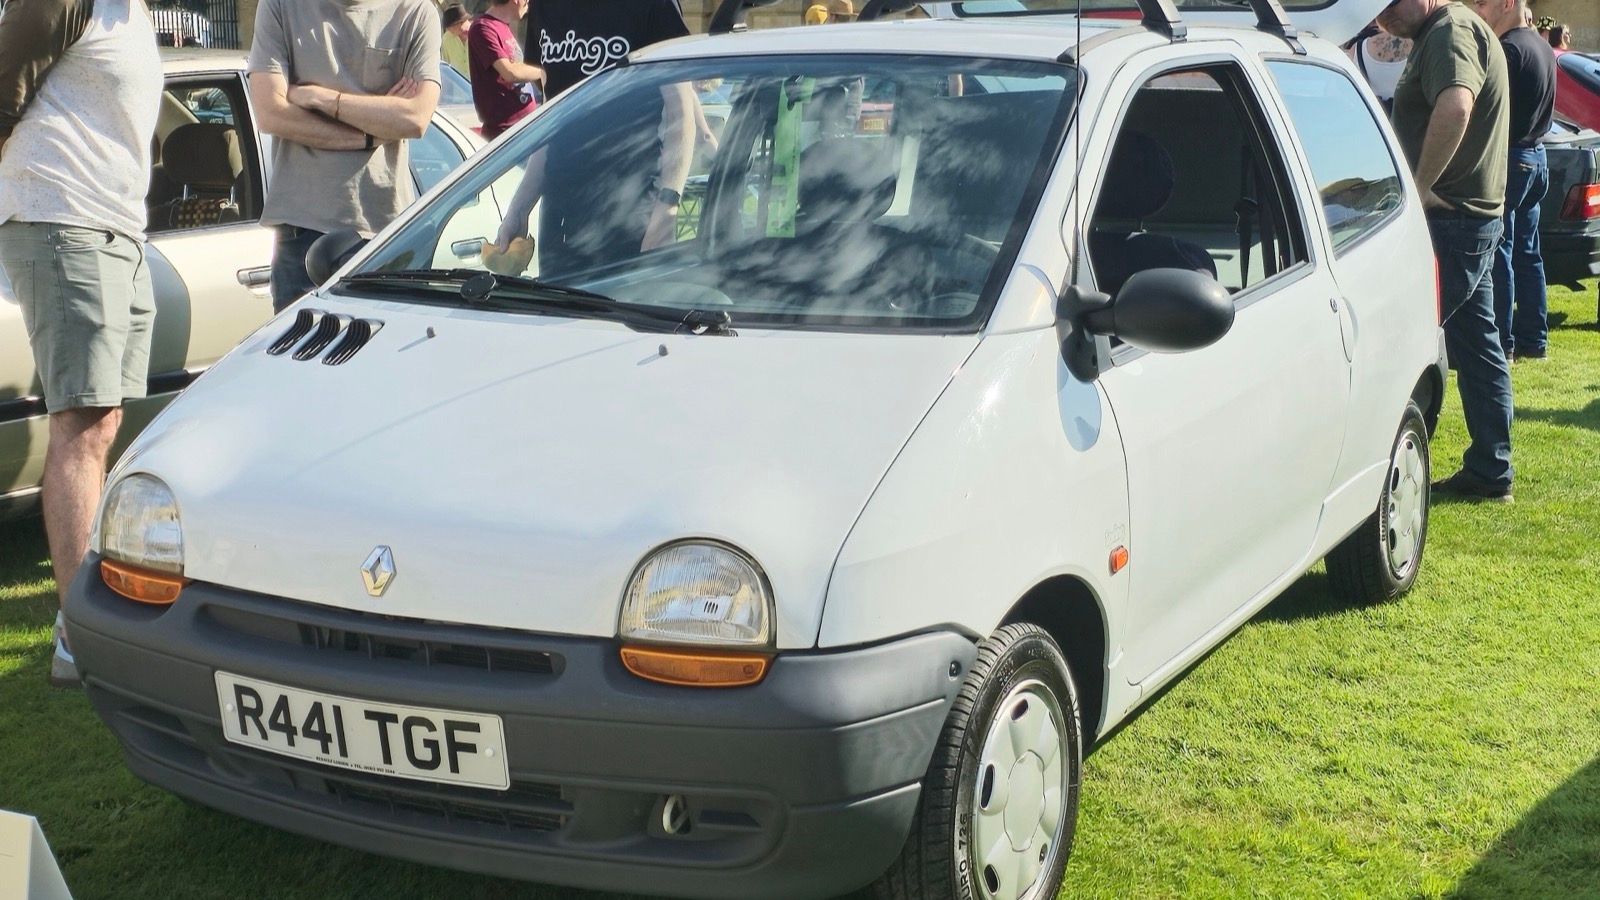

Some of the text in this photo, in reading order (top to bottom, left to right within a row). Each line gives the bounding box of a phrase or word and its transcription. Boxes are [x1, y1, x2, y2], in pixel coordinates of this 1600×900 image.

[538, 28, 630, 76] twingo
[233, 683, 481, 774] R441 TGF
[959, 813, 968, 851] 726
